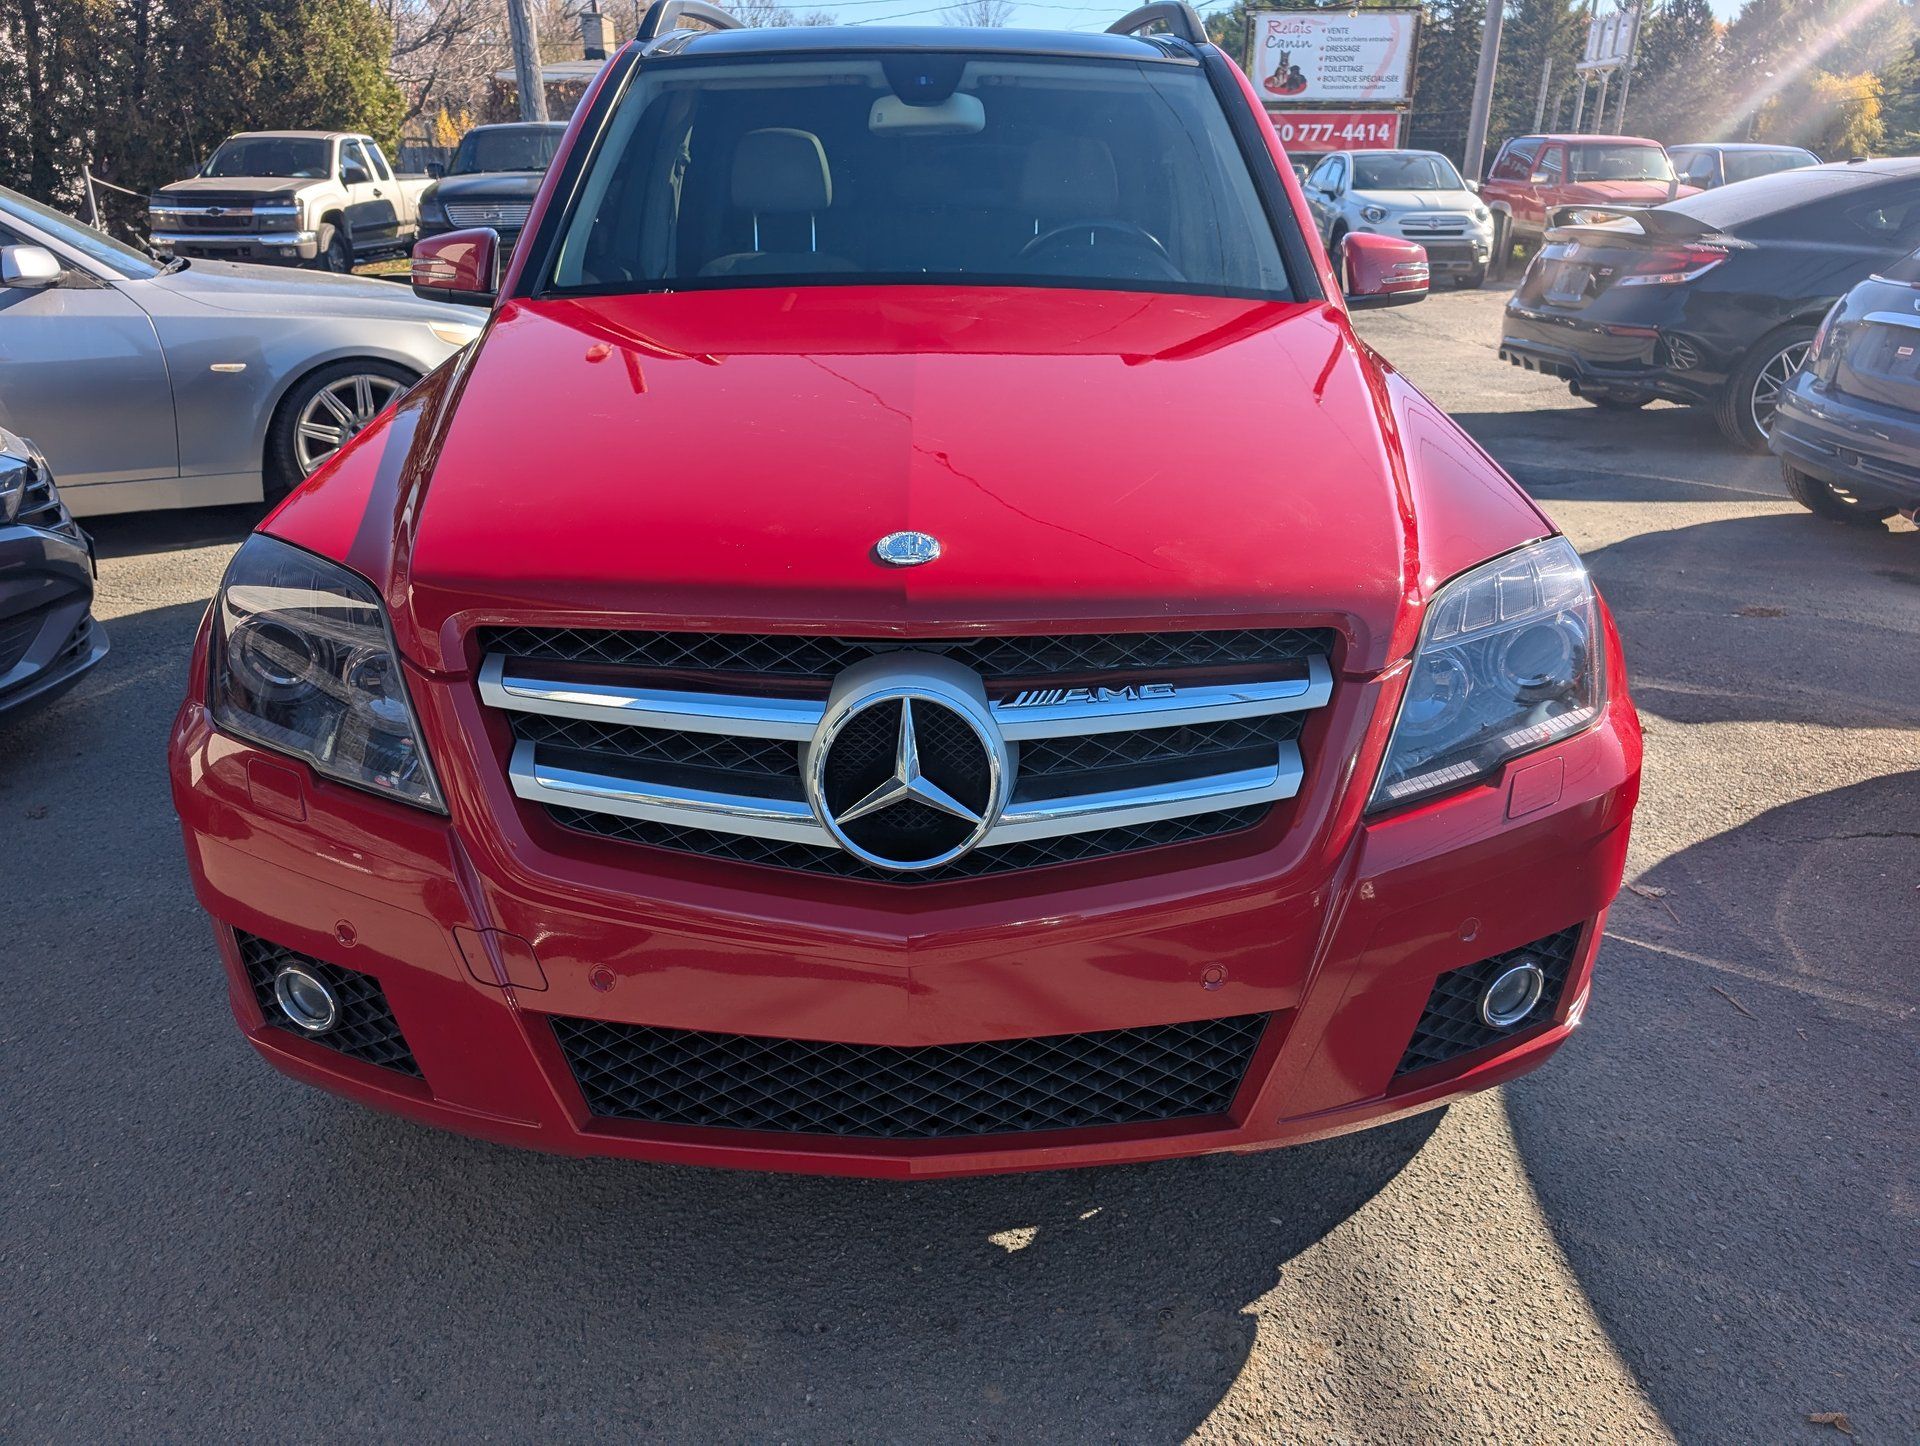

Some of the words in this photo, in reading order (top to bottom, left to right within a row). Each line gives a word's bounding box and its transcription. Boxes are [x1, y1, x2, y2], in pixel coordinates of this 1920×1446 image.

[1267, 20, 1312, 35] Relais
[1327, 27, 1349, 35] VENTE
[1265, 35, 1312, 49] Canin
[1325, 45, 1360, 53] DRESSAGE
[1325, 55, 1354, 63] PENSION
[1324, 65, 1364, 73] TOILETTAGE
[1323, 75, 1357, 83] BOUTIQUE
[1297, 122, 1390, 142] 777-4414
[1054, 683, 1177, 706] AMG
